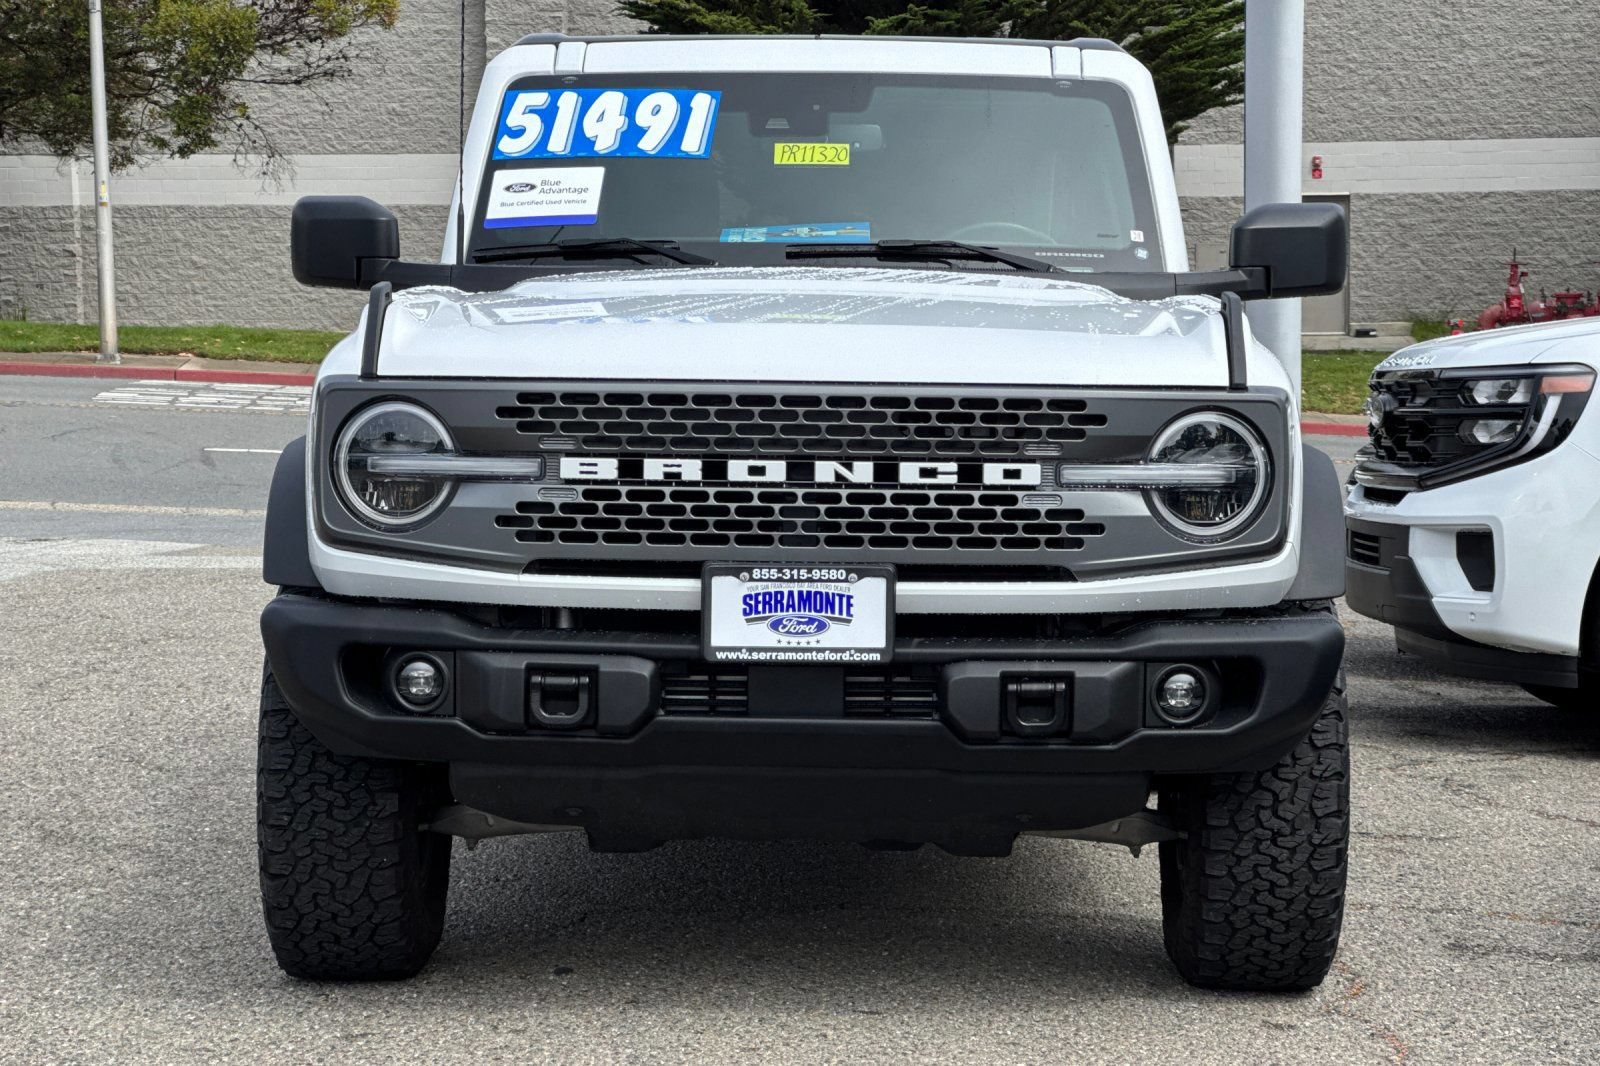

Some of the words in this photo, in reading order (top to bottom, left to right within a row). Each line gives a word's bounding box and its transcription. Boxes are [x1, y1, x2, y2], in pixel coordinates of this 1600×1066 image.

[497, 91, 715, 155] 51491
[780, 144, 848, 163] PR11320
[540, 179, 561, 187] Blue
[538, 186, 589, 195] Advantage
[516, 199, 544, 207] Certified
[560, 457, 1042, 486] BRONCO
[752, 568, 846, 580] 855-315-9580
[742, 590, 854, 618] SERRAMONTE
[778, 617, 819, 634] Ford
[715, 650, 881, 661] www.serramonteford.com
